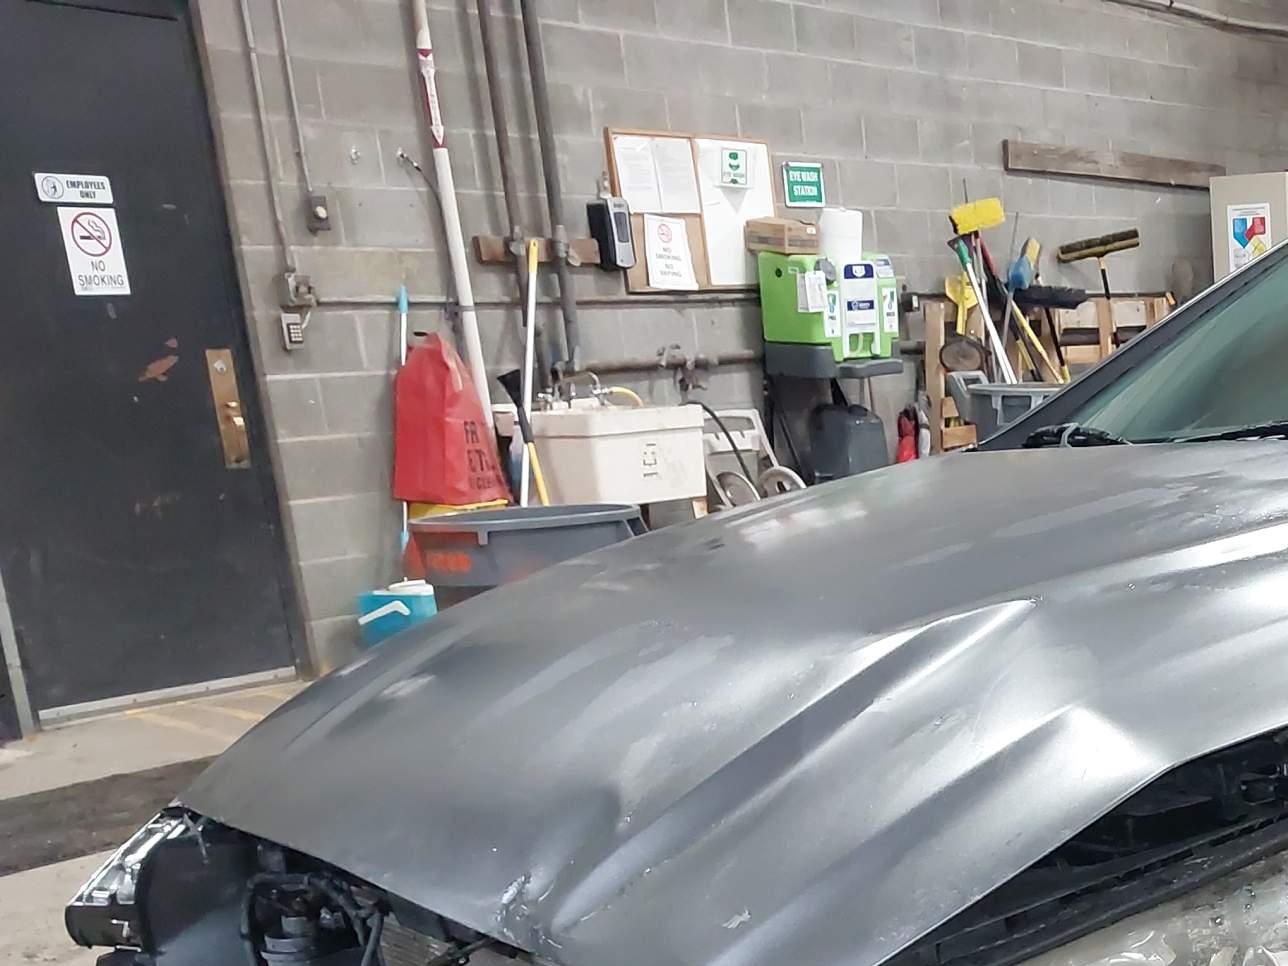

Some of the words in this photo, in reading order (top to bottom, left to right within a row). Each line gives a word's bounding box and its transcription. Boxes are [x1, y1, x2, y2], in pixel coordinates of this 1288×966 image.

[66, 180, 106, 190] EMPLOYEES
[79, 191, 96, 199] ONLY
[91, 260, 106, 272] NO
[77, 274, 124, 287] SMOKING
